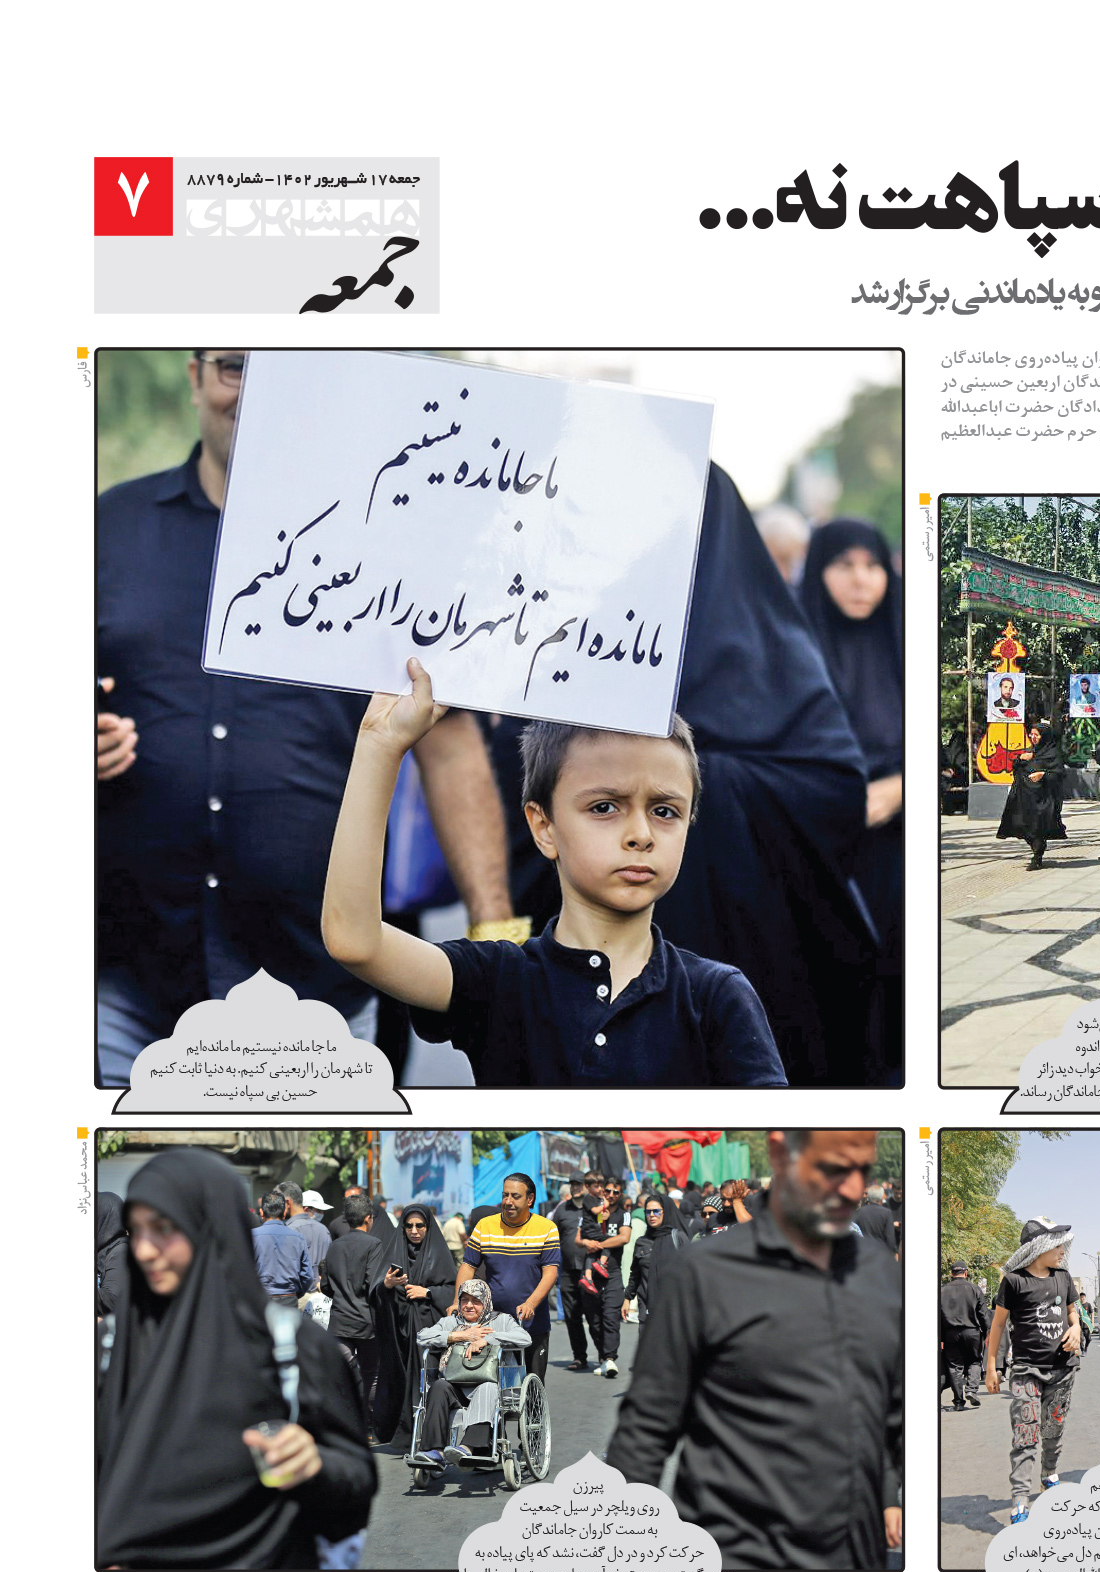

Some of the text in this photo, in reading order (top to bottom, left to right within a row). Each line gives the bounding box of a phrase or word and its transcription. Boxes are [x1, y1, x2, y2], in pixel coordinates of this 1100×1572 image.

[117, 171, 150, 218] ۷
[188, 174, 223, 185] ۸۸۷۹
[227, 173, 263, 187] شماره
[372, 175, 387, 185] ۱۷
[389, 175, 420, 187] جمعه
[299, 236, 420, 314] جمعه
[78, 362, 91, 387] فارس
[941, 350, 1011, 368] جاماندگان
[365, 387, 470, 525] نیستیم
[543, 455, 560, 500] ما
[920, 508, 933, 561] امیر رستمی
[218, 500, 341, 656] کنیم
[282, 554, 385, 634] اربعینی
[391, 579, 415, 627] را
[411, 573, 525, 651] شهرمان
[513, 589, 550, 646] تا
[240, 1085, 263, 1099] سپاه
[266, 1091, 279, 1101] بی
[282, 1090, 317, 1101] حسین
[920, 1142, 933, 1195] امیر رستمی
[573, 1482, 604, 1494] پیرزن
[520, 1500, 659, 1516] روی ویلچر در سیل جمعیت
